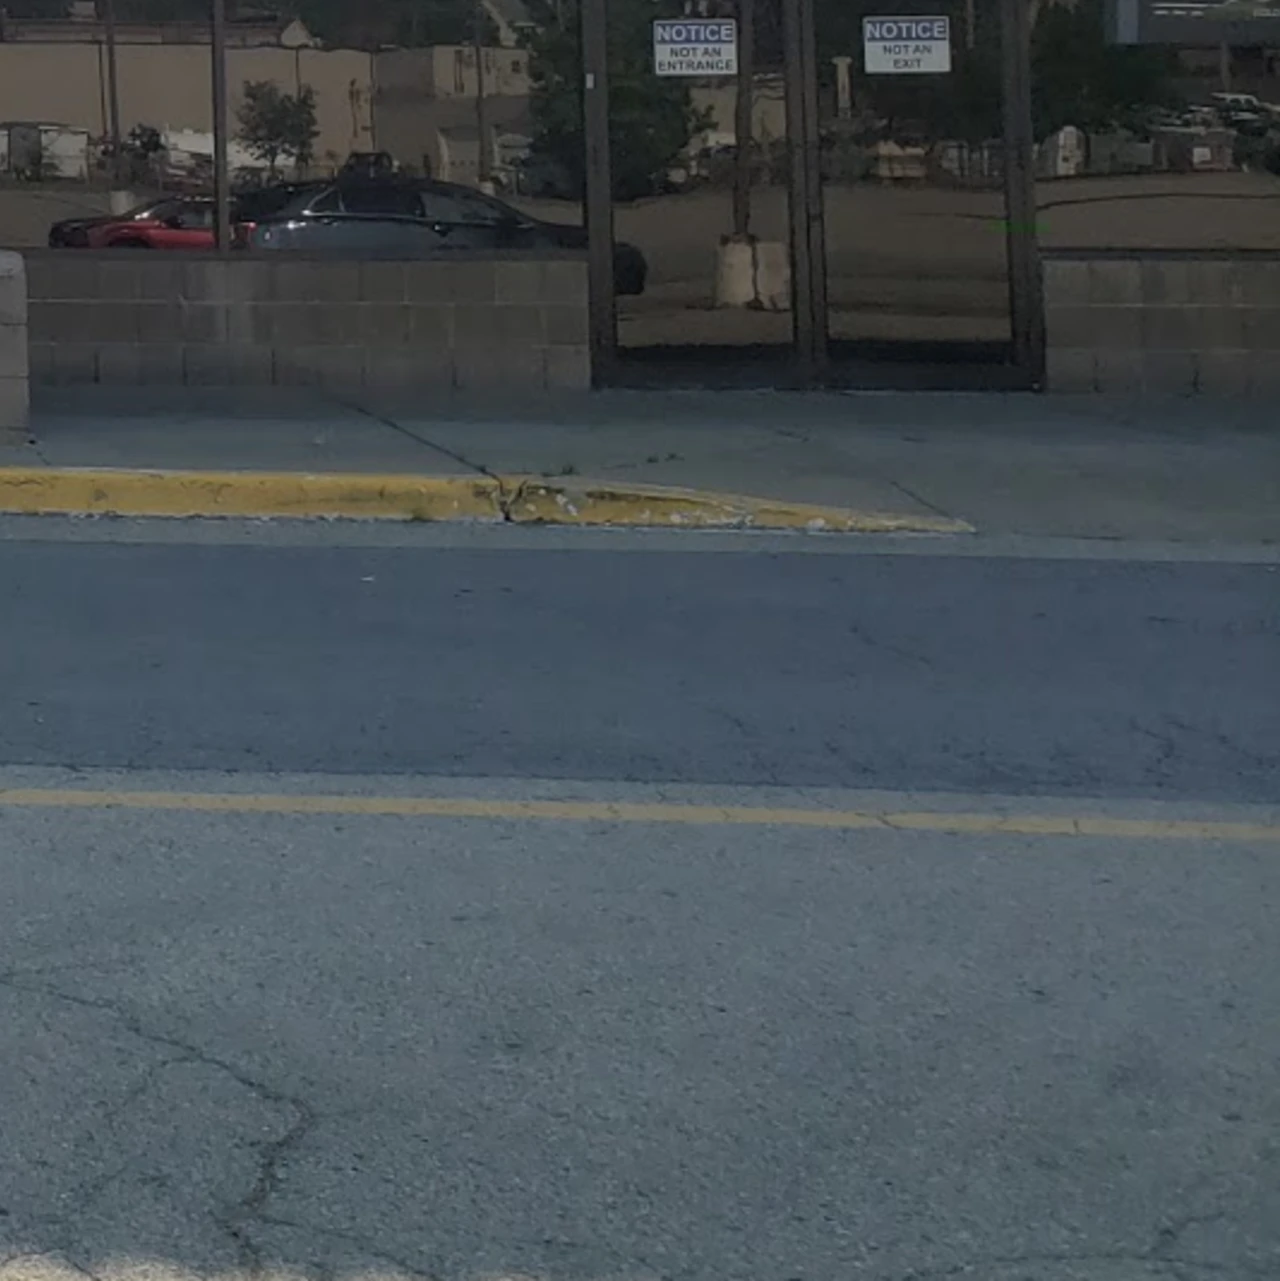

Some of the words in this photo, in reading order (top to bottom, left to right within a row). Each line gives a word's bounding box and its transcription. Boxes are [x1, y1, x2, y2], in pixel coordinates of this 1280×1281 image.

[657, 25, 733, 41] NOTICE
[866, 22, 946, 39] NOTICE
[669, 46, 697, 58] NOT
[701, 46, 722, 58] AN
[883, 44, 910, 56] NOT
[912, 44, 933, 56] AN
[658, 59, 733, 72] ENTRANCE
[893, 59, 922, 69] EXIT
